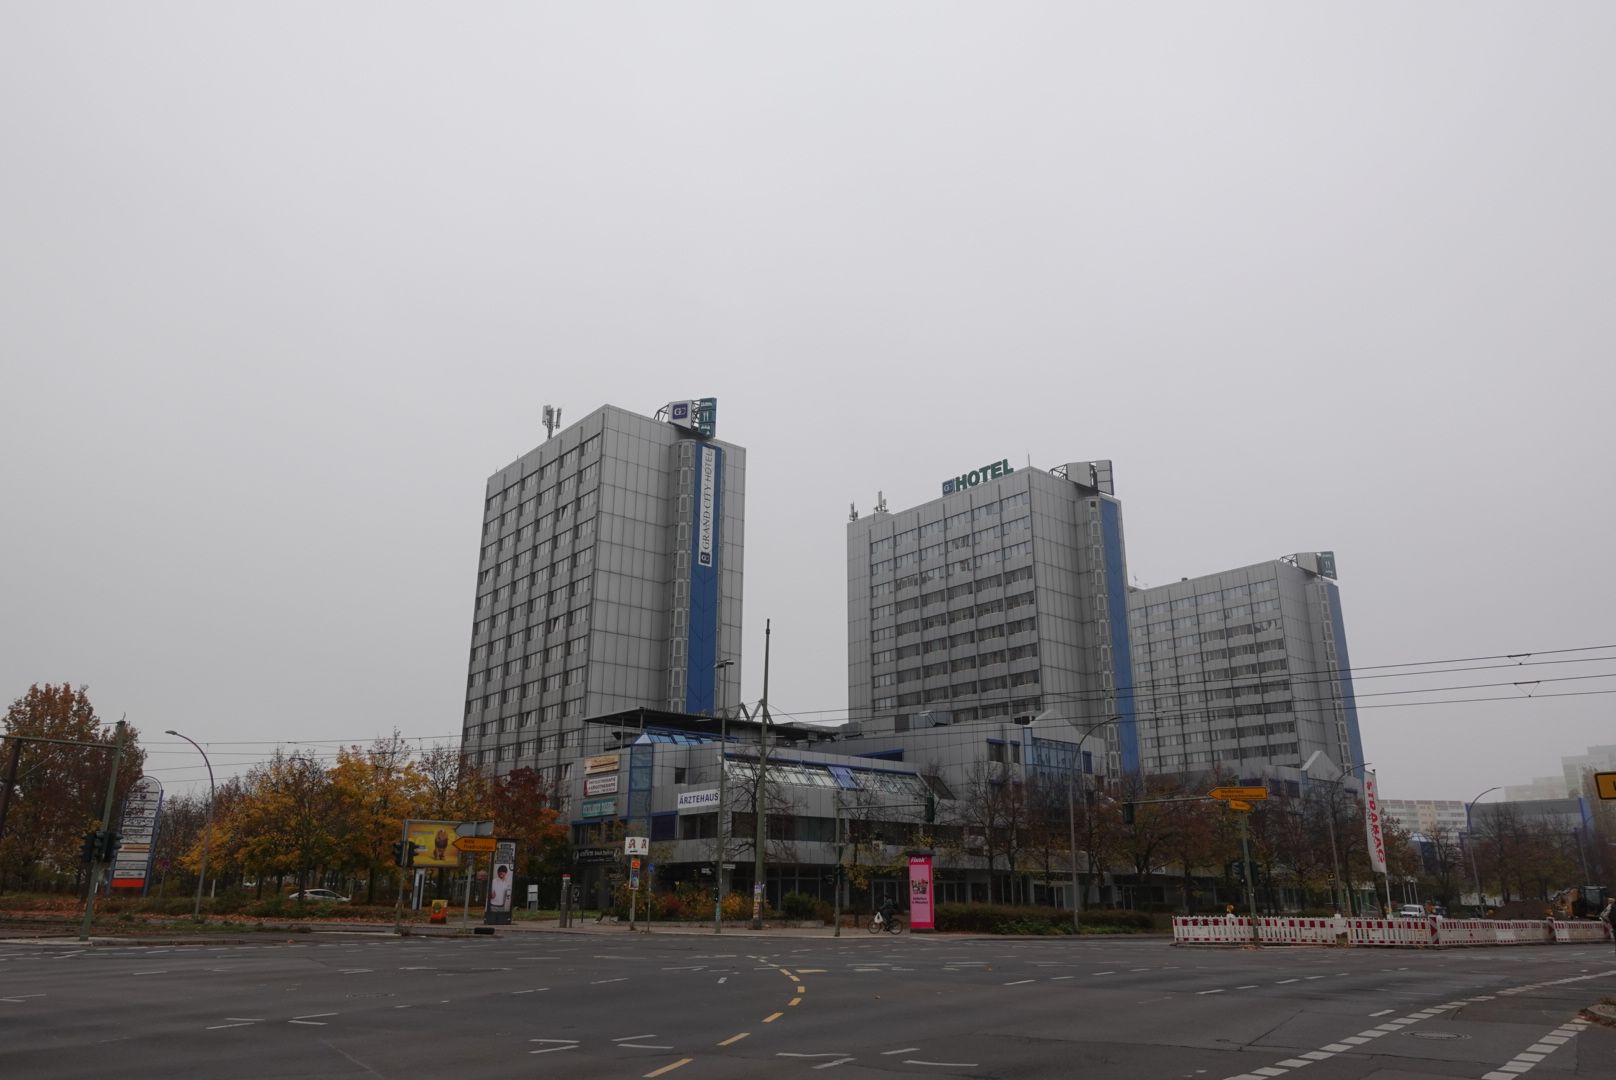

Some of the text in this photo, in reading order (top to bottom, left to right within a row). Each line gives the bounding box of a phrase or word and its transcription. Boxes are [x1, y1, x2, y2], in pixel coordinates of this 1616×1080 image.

[702, 451, 713, 550] GRAND CITY HOTEL
[955, 458, 1014, 492] HOTEL
[679, 792, 719, 805] ÄRZTEHAUS
[1366, 780, 1385, 864] STRABAG
